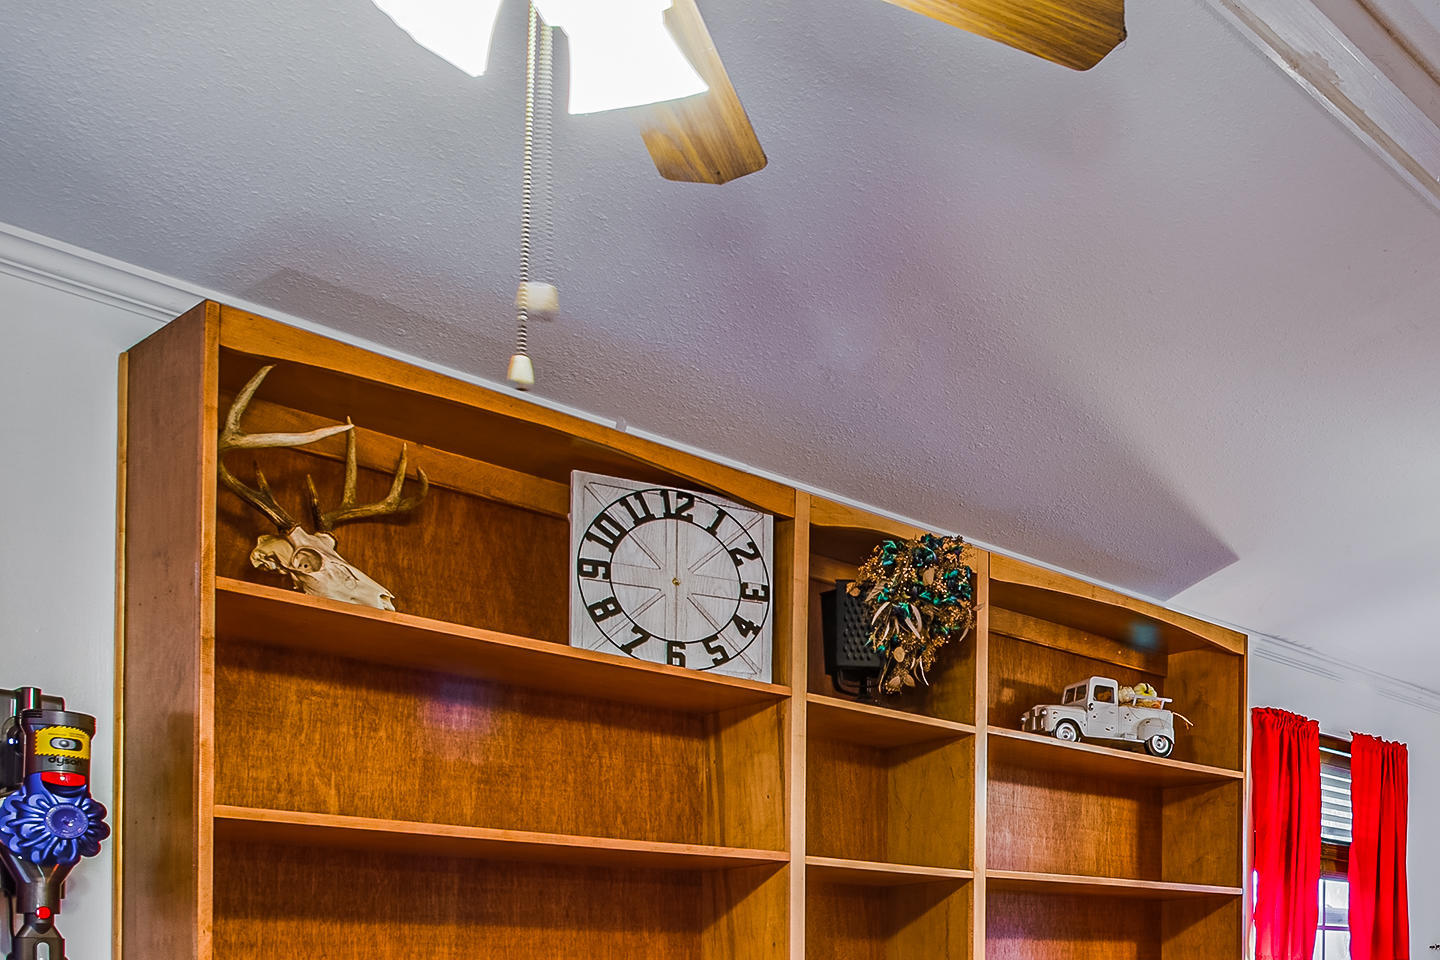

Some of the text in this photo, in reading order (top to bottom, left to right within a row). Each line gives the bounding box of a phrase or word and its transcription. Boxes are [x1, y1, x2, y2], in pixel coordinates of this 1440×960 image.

[619, 490, 656, 526] 11
[661, 488, 695, 523] 12
[585, 512, 628, 554] 10
[706, 508, 727, 537] 1
[729, 541, 761, 567] 2
[578, 557, 611, 580] 9
[740, 582, 769, 603] 3
[588, 596, 623, 623] 8
[732, 613, 761, 638] 4
[620, 625, 651, 655] 7
[702, 634, 730, 667] 5
[667, 641, 686, 668] 6
